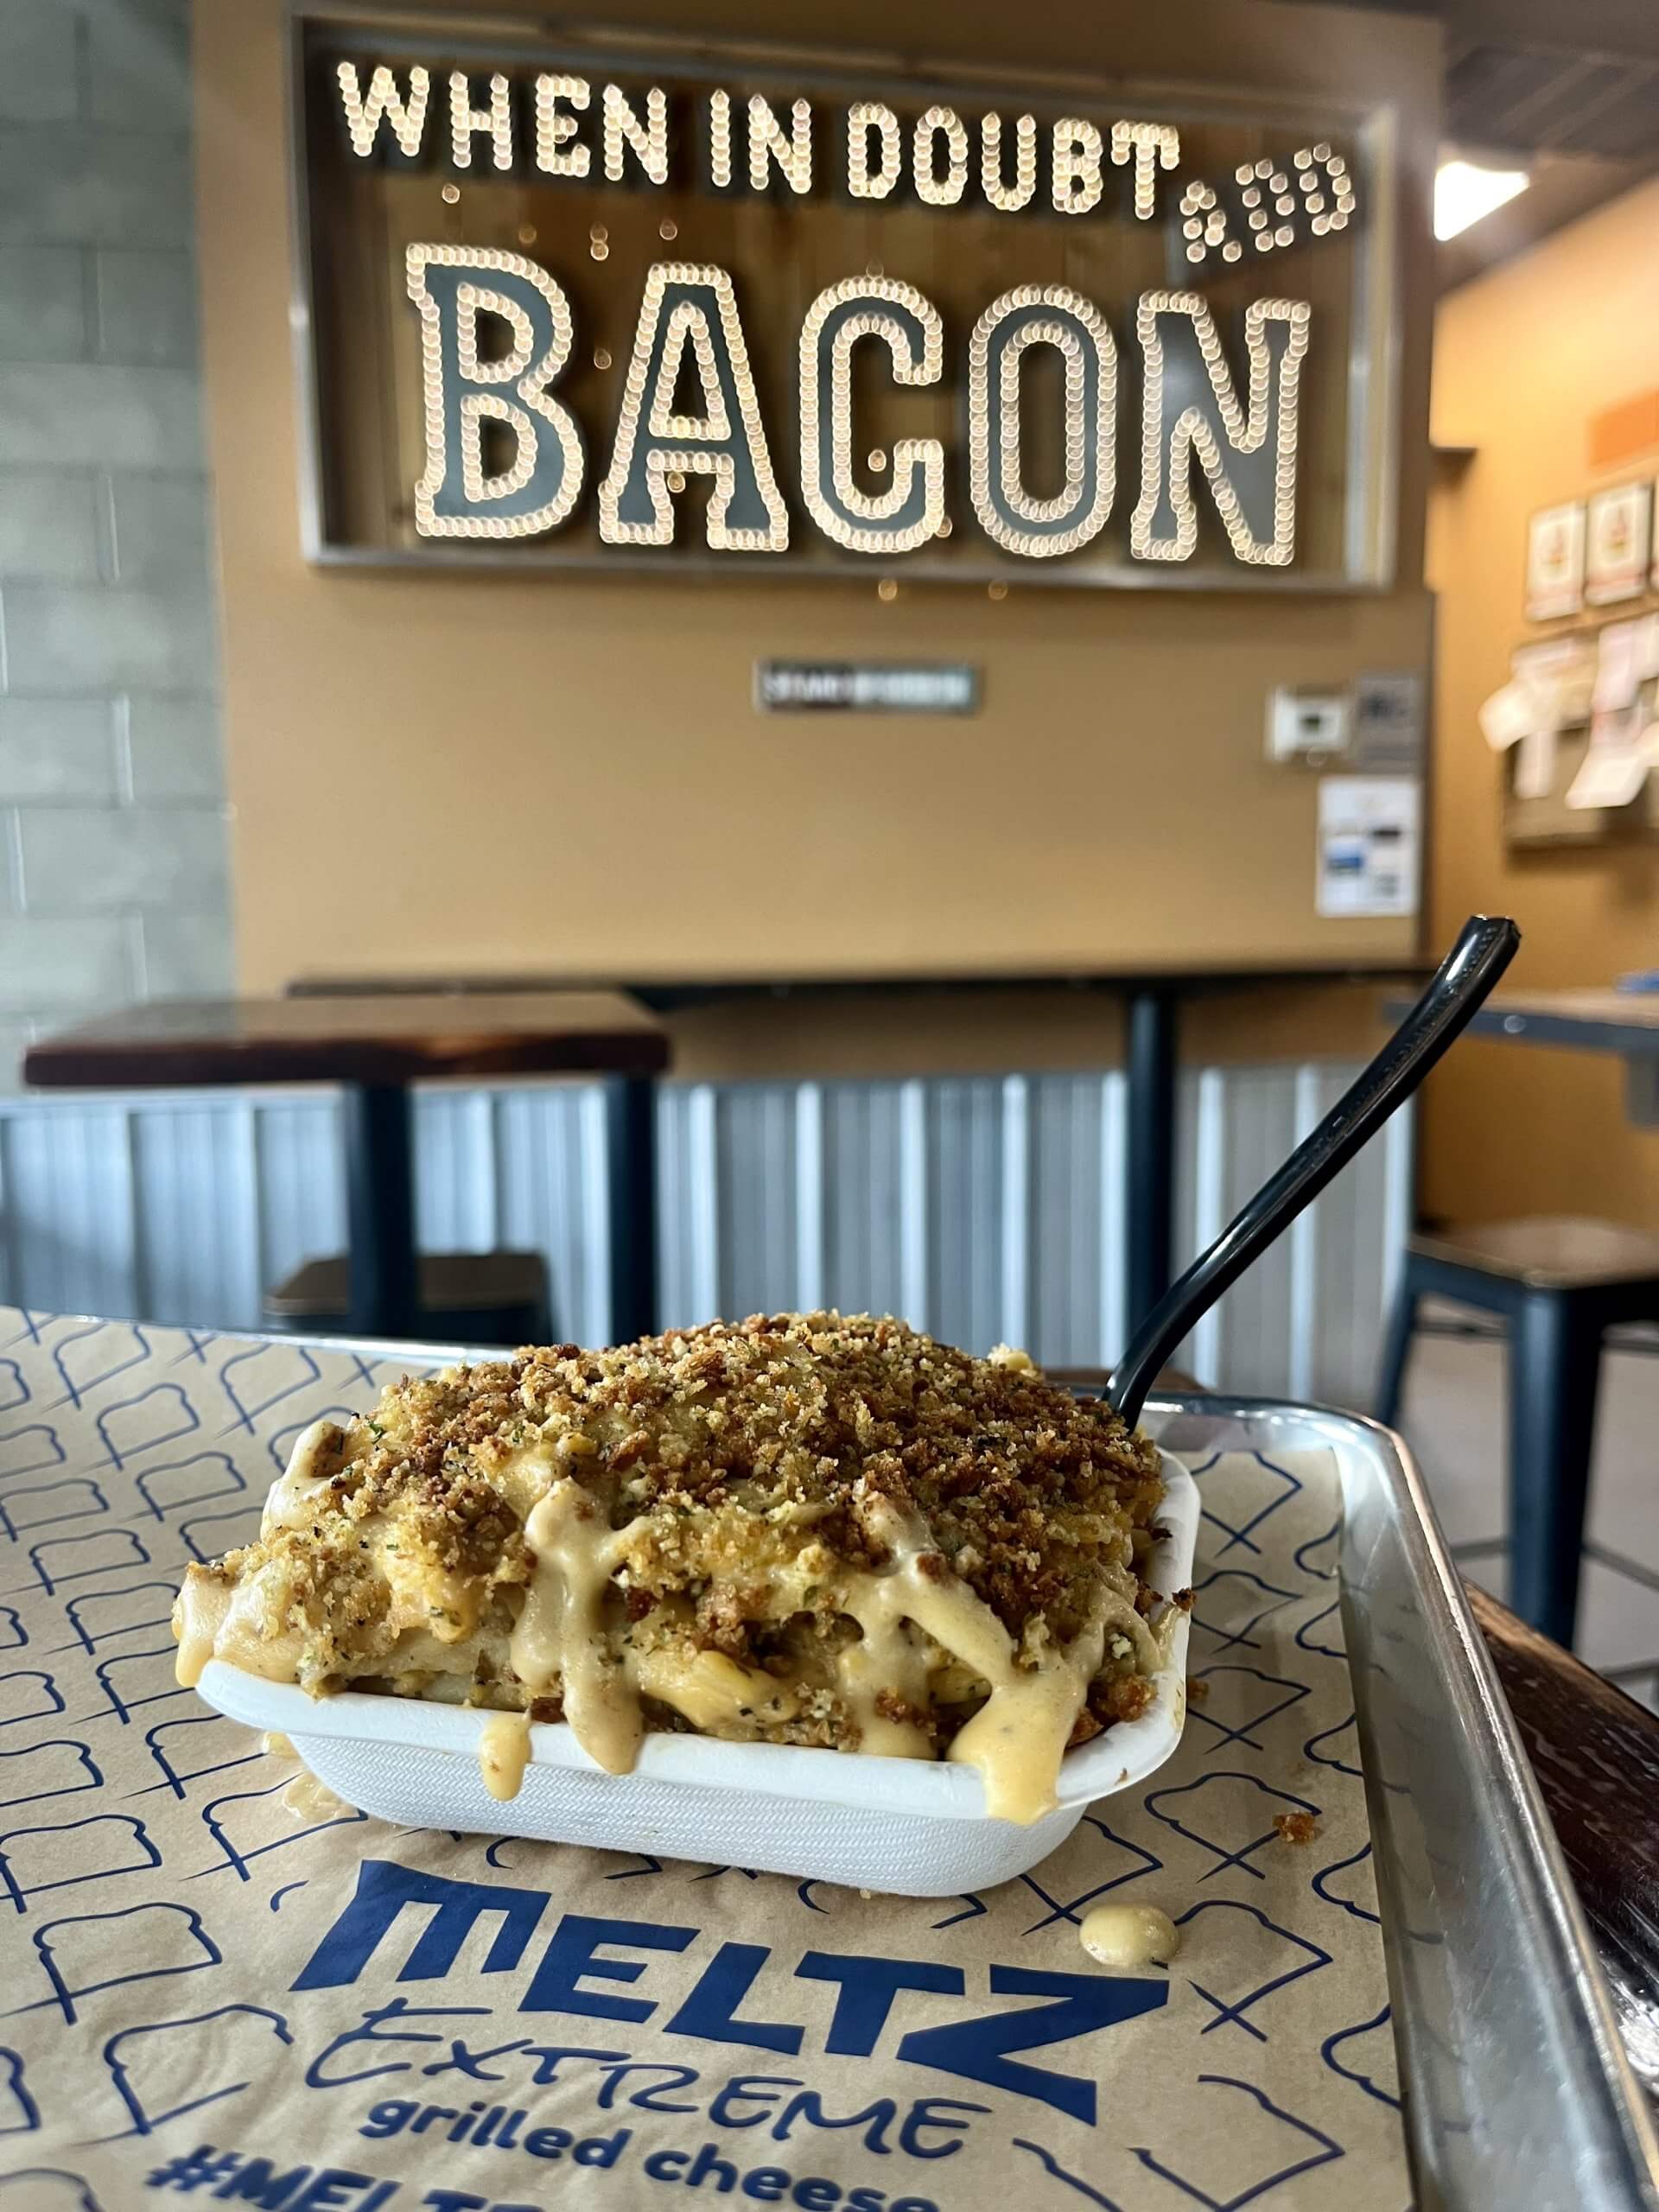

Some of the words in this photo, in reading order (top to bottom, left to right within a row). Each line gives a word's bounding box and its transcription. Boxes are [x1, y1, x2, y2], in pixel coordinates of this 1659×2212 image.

[335, 60, 668, 183] WHEN
[709, 90, 815, 196] IN
[846, 102, 1181, 220] DOUBT
[406, 243, 1311, 566] BACON
[289, 1859, 1169, 2126] MELTZ
[357, 2099, 634, 2170] grilled
